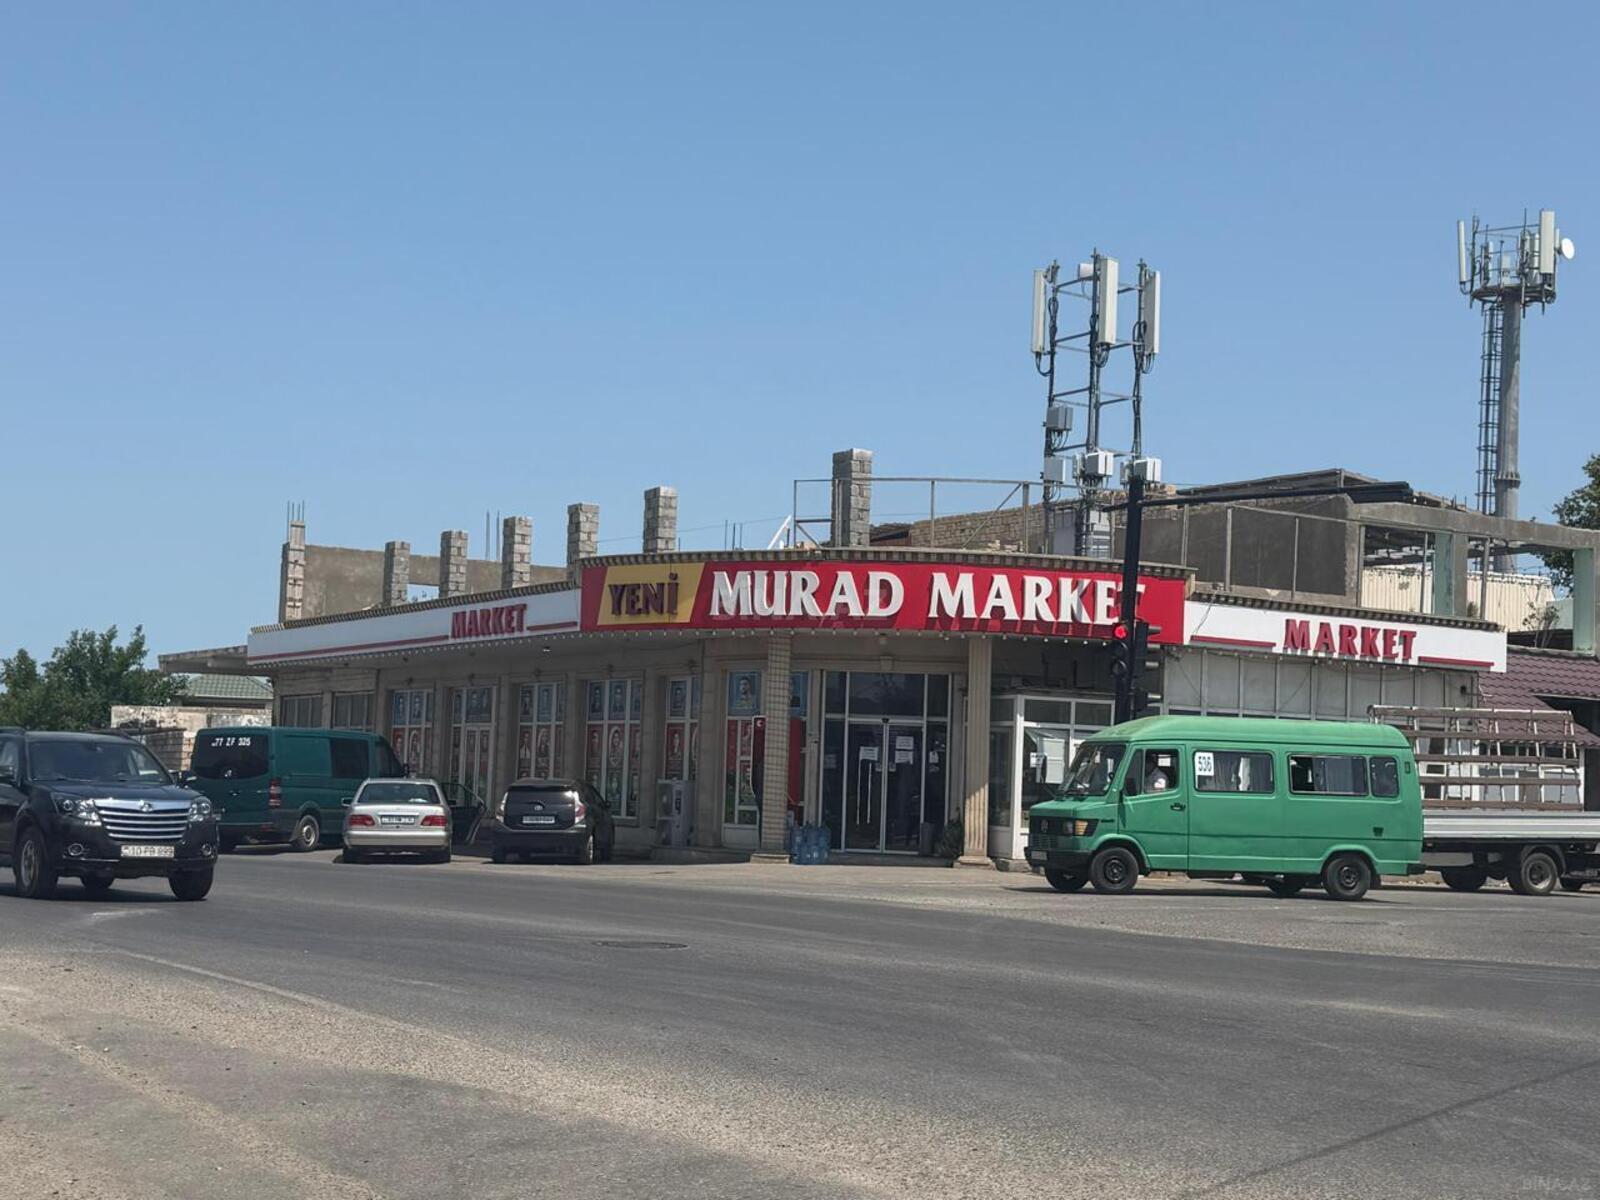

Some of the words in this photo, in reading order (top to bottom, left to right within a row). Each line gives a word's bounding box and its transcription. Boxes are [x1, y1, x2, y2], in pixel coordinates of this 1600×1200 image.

[608, 572, 679, 616] YENİ
[709, 570, 904, 617] MURAD
[928, 571, 1146, 625] MARKE
[451, 603, 527, 639] MARKET
[1283, 618, 1417, 661] MARKET
[1198, 755, 1212, 772] 536
